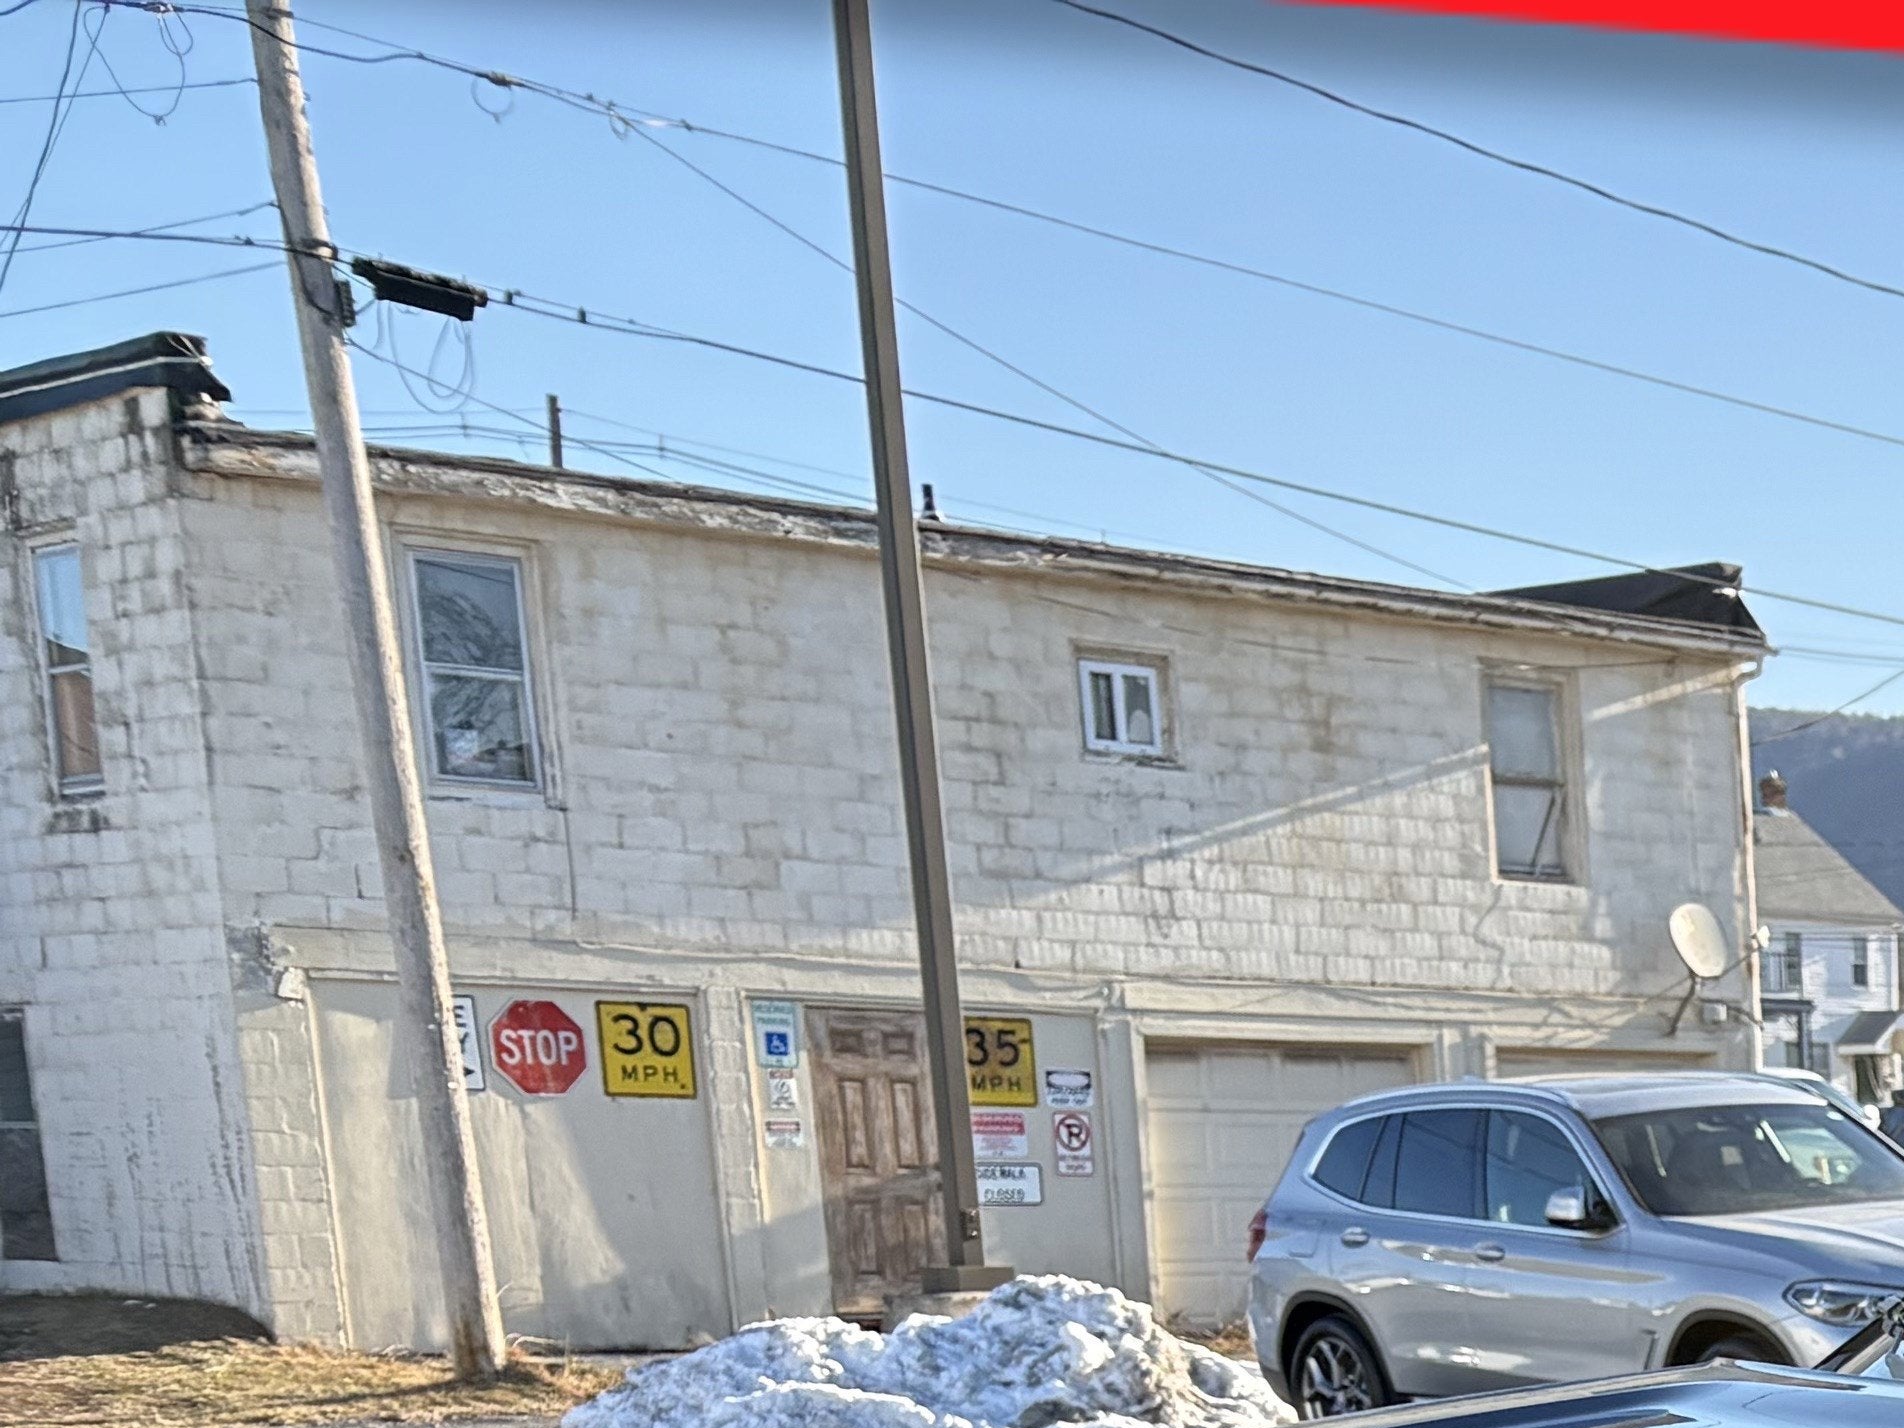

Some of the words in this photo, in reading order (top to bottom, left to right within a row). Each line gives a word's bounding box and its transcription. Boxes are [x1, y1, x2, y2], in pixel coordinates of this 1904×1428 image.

[500, 1029, 578, 1065] STOP
[612, 1013, 682, 1057] 30
[965, 1028, 1020, 1067] 35
[621, 1065, 678, 1082] MPH
[971, 1075, 1022, 1091] MPH
[983, 1188, 1026, 1201] CLOSED
